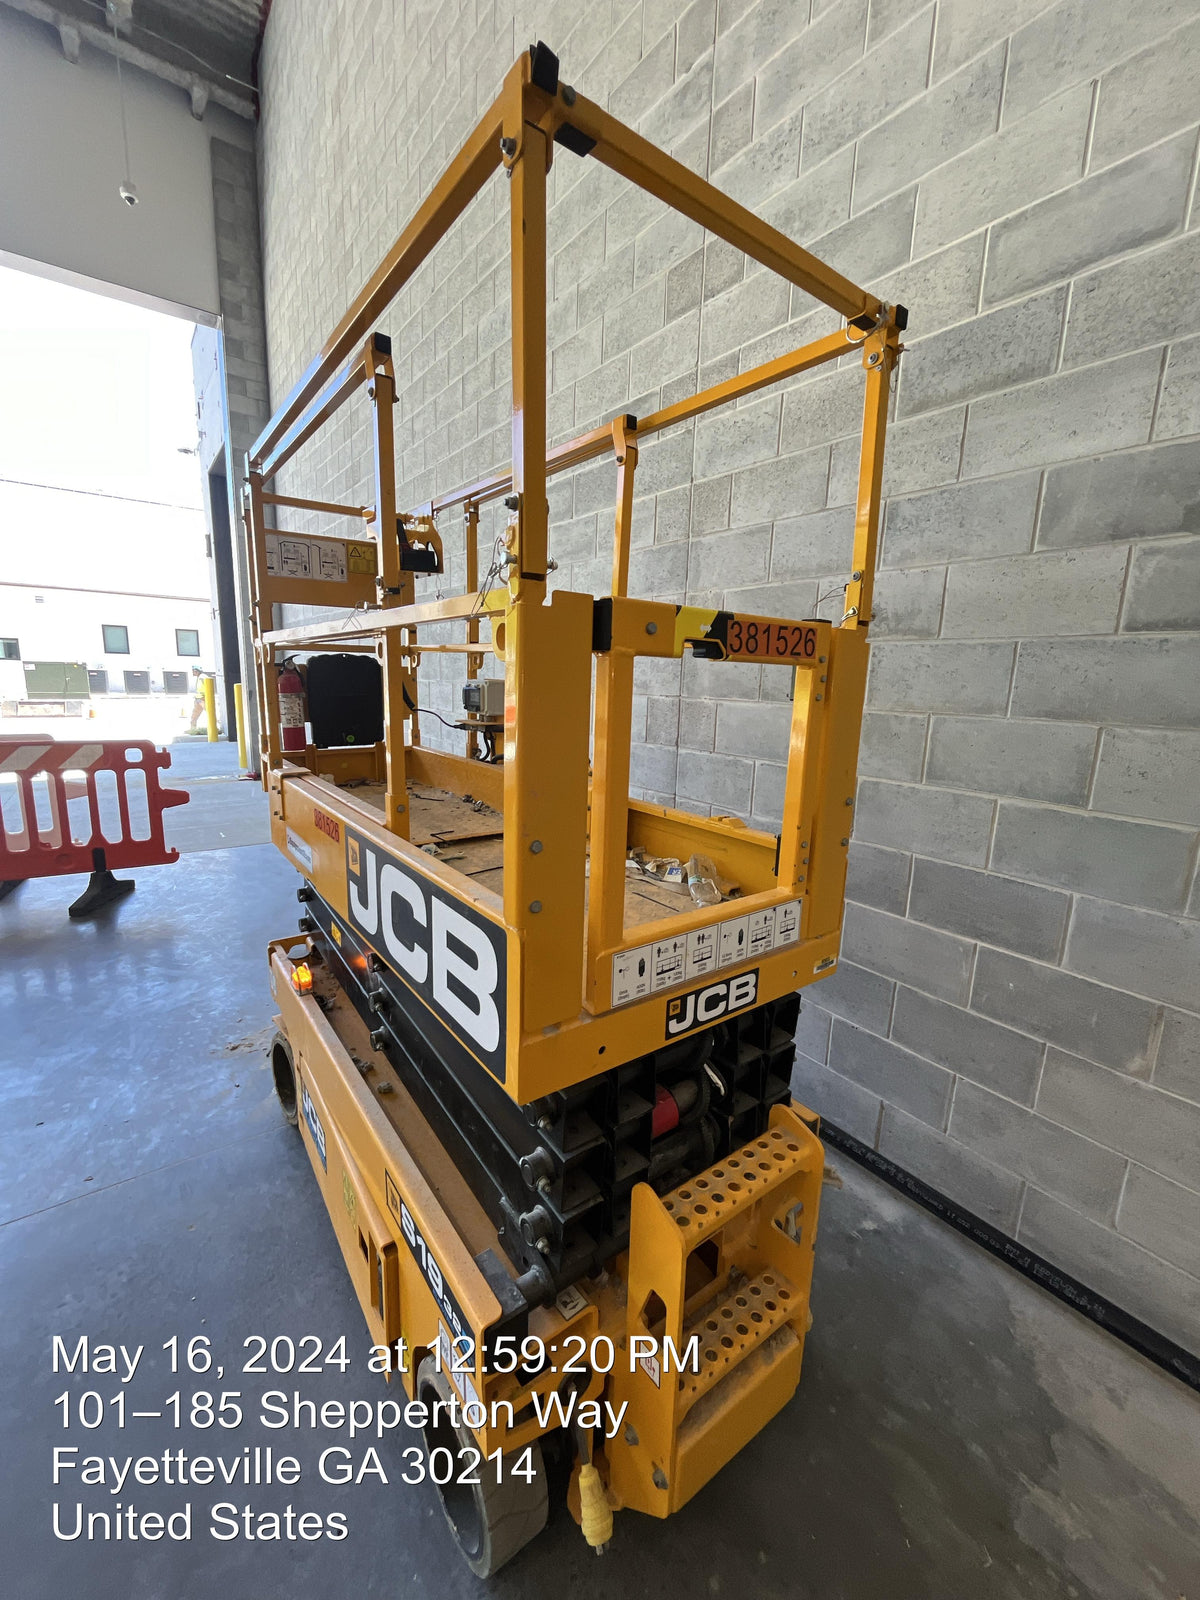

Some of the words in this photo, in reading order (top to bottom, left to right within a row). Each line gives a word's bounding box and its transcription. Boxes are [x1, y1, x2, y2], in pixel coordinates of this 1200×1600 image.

[728, 619, 817, 658] 381526
[349, 848, 500, 1053] JCB
[668, 972, 756, 1034] JCB
[302, 1088, 327, 1158] JCB
